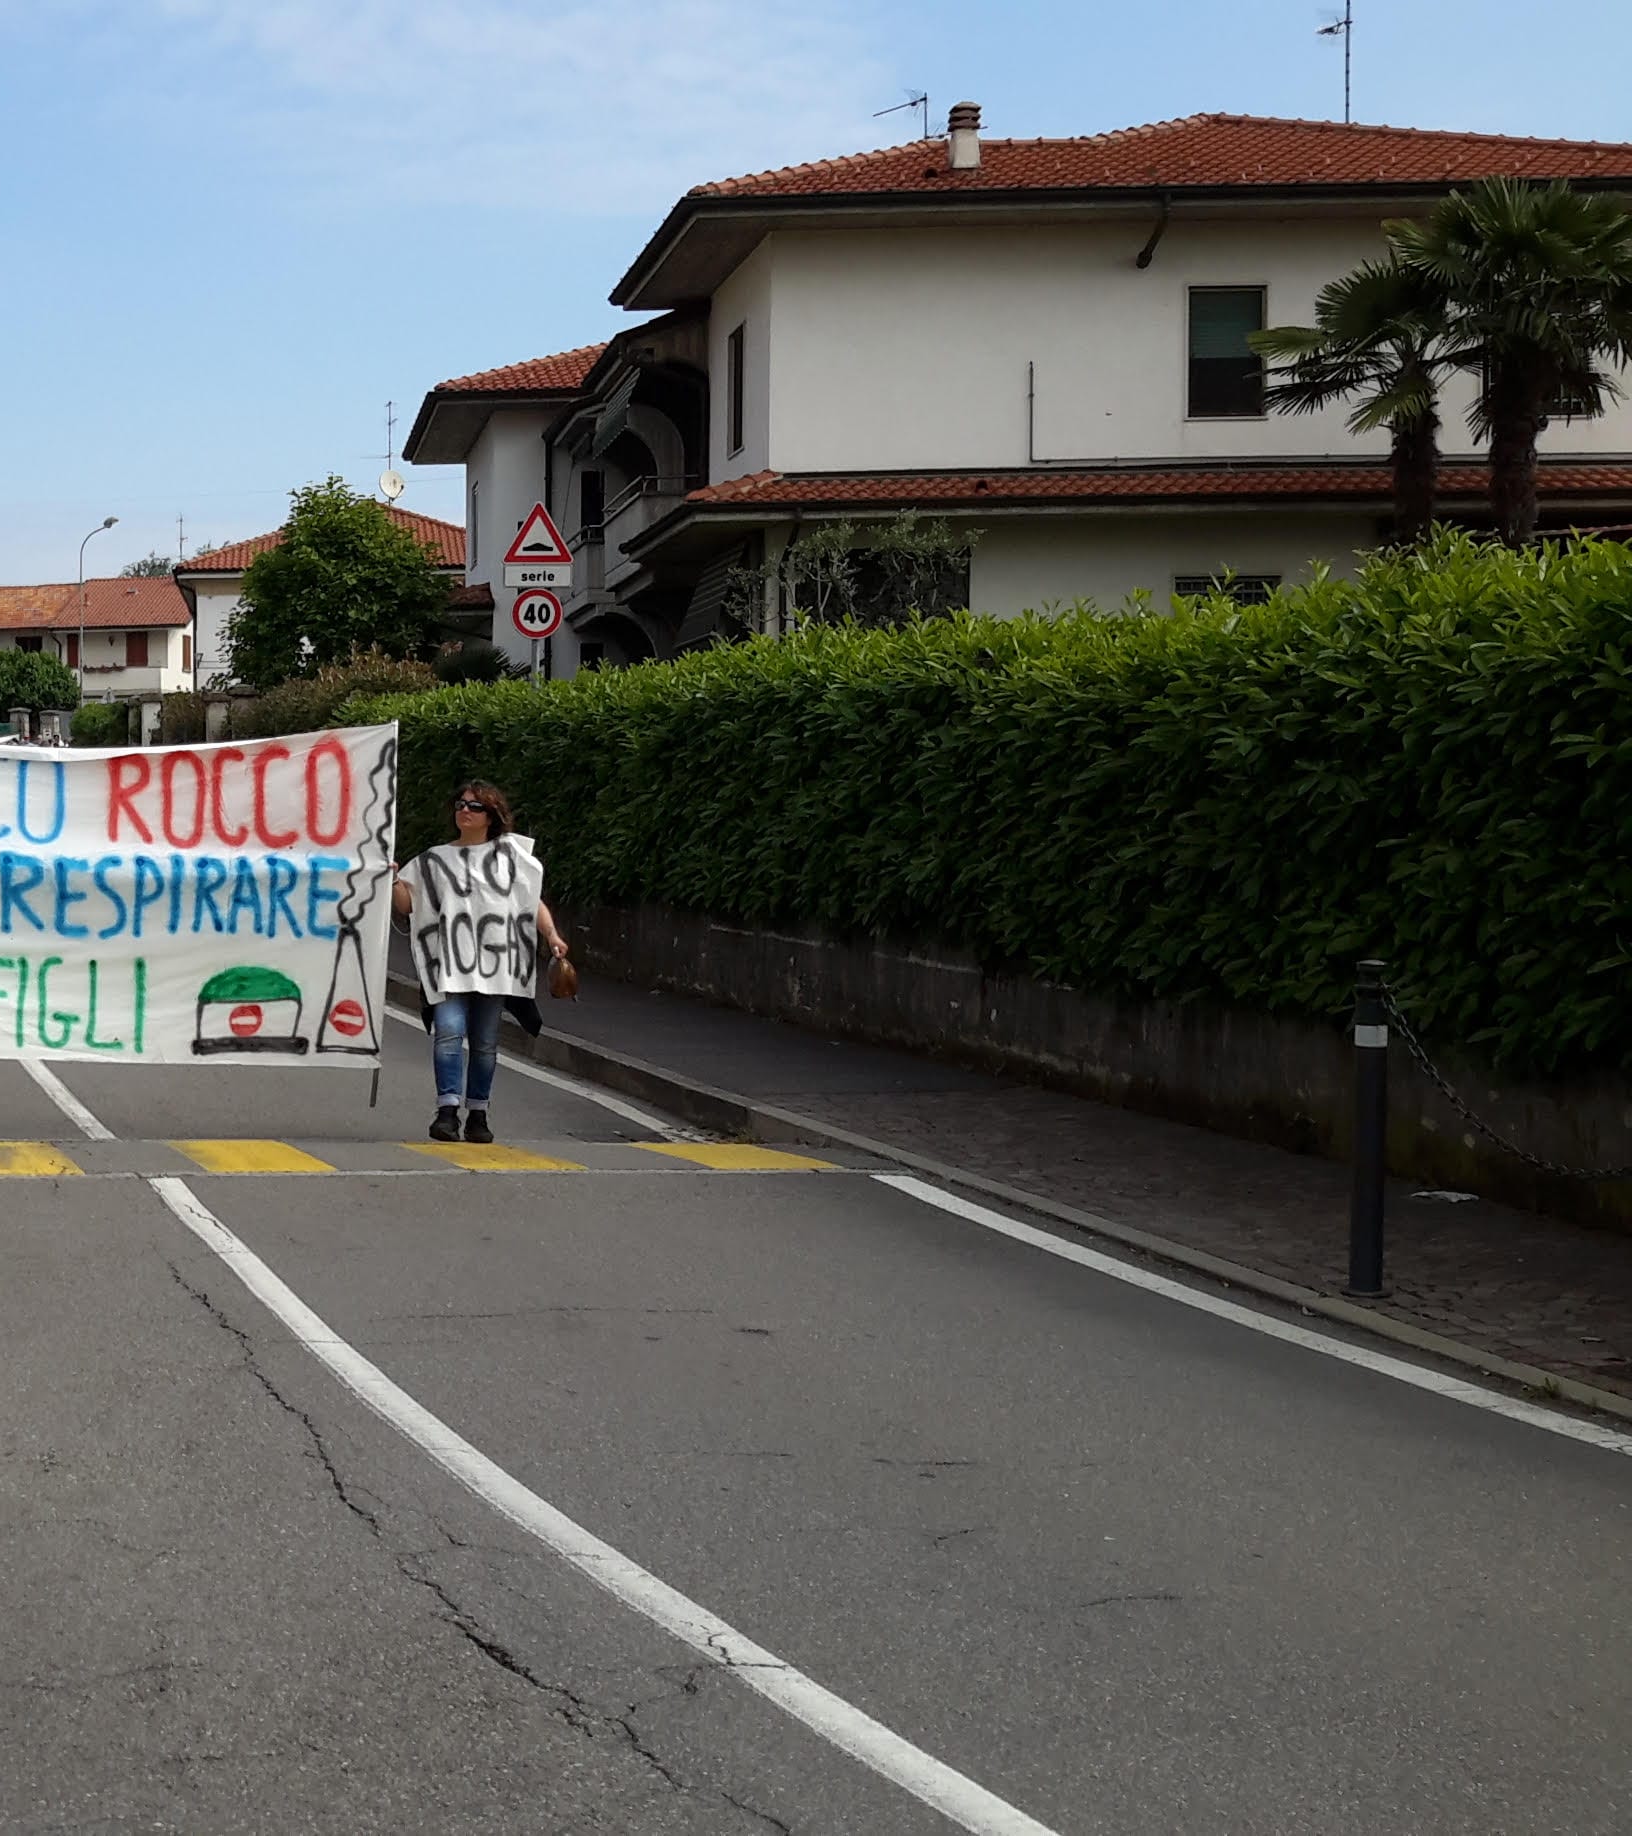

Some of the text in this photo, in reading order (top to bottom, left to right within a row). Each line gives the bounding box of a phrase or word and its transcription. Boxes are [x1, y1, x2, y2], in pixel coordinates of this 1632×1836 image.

[521, 571, 555, 582] serie
[523, 603, 551, 624] 40
[104, 736, 353, 850] ROCCO
[419, 836, 517, 912] NO
